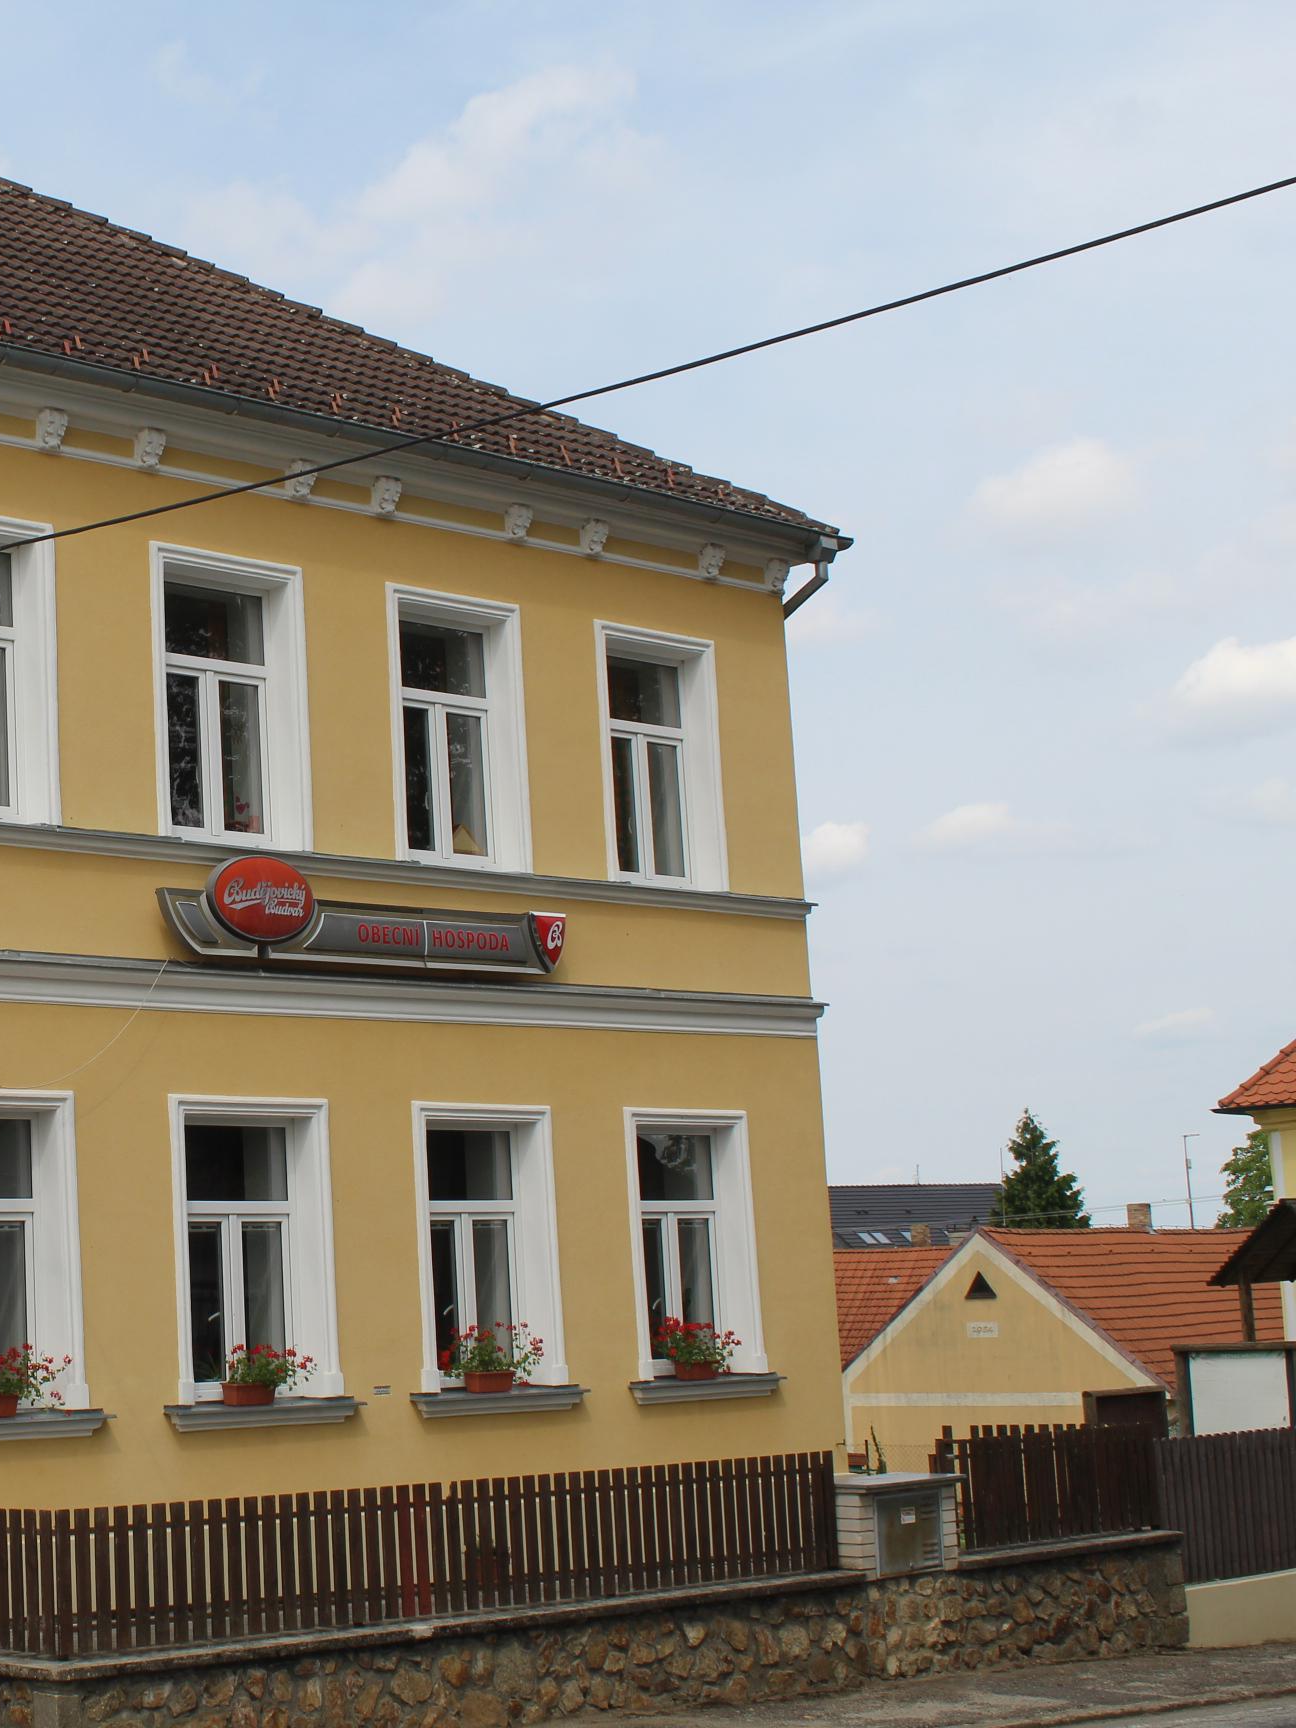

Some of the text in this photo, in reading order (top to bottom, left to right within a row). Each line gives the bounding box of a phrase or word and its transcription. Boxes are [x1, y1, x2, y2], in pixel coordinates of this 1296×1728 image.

[265, 898, 305, 917] Budvar
[357, 923, 510, 951] OBECNÍ HOSPODA
